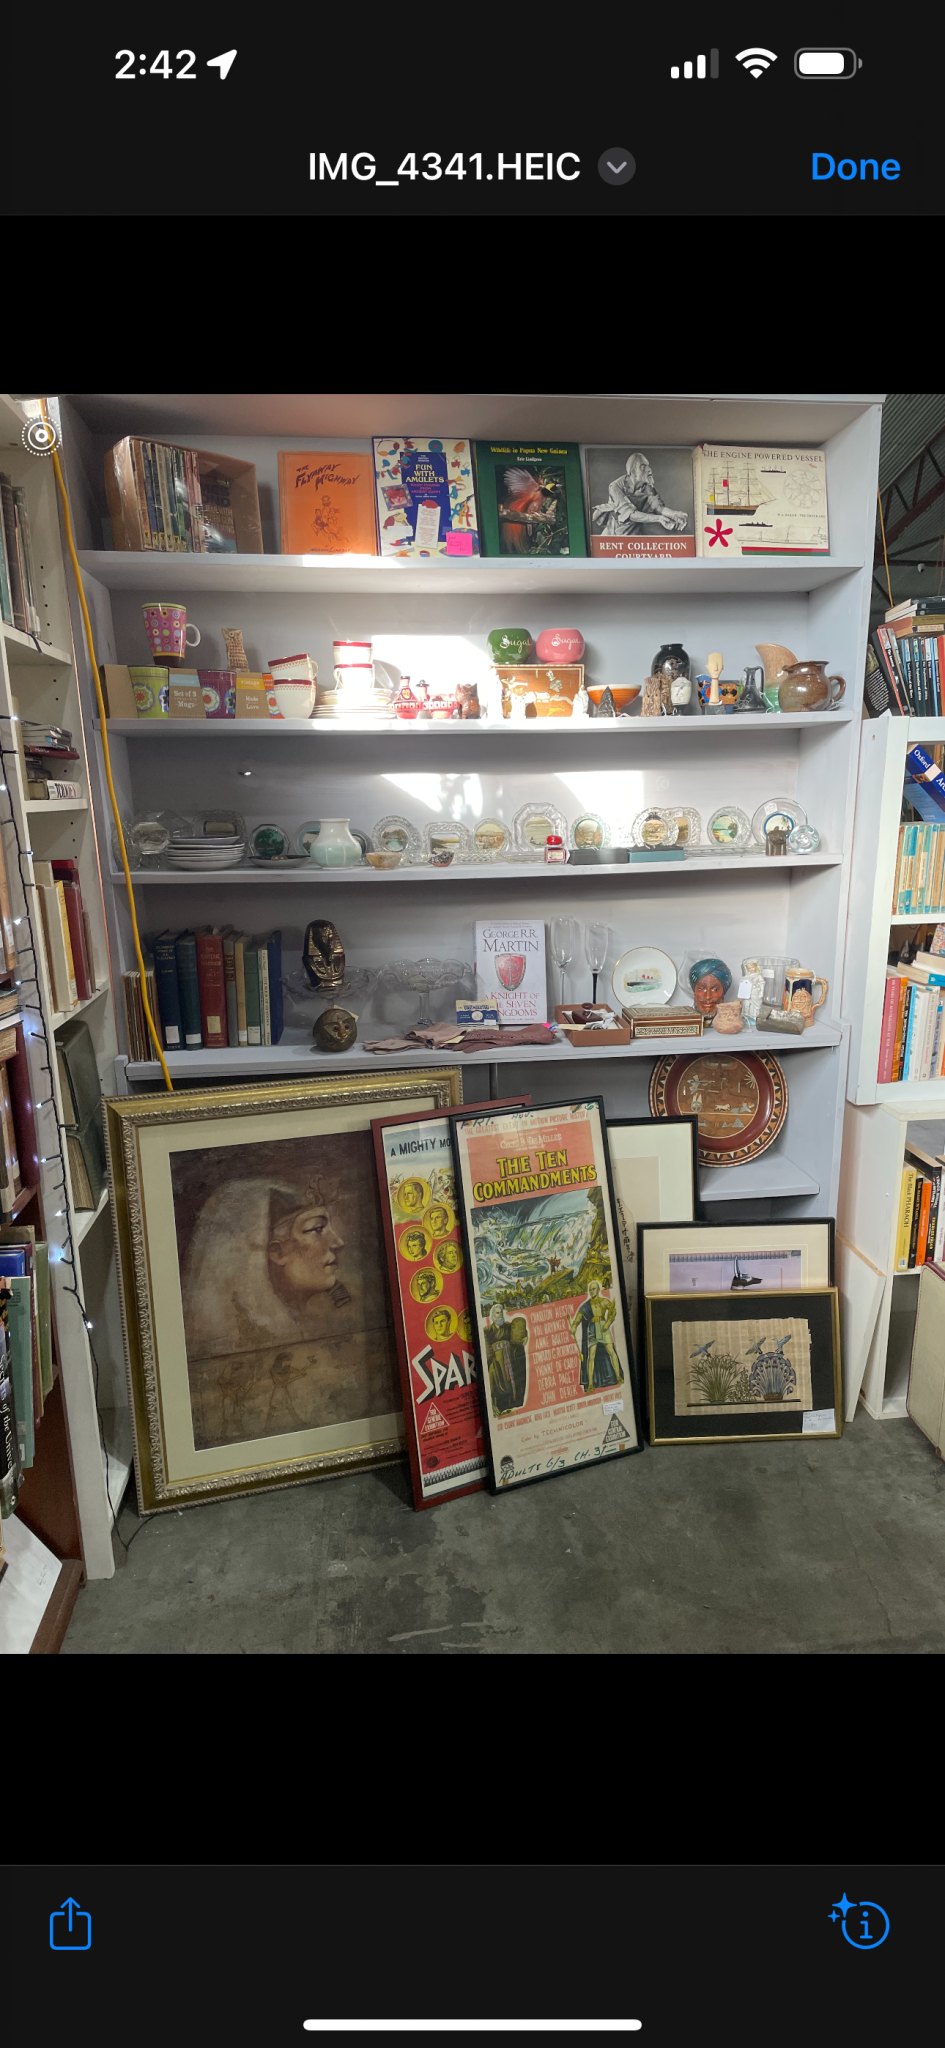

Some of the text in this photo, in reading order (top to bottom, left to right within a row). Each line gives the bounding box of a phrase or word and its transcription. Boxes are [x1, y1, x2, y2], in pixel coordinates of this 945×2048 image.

[720, 451, 752, 459] ENGINE
[795, 454, 824, 462] VESSEL
[295, 464, 341, 489] FLYAWAY
[296, 464, 309, 473] THE
[315, 474, 360, 492] HIGHWAY
[600, 542, 687, 550] RENT COLLECTION
[500, 634, 532, 653] Sugar
[552, 633, 581, 650] Sugar
[914, 750, 931, 769] Oxford
[483, 929, 518, 938] GEORGE
[483, 939, 539, 952] MARTIN
[476, 1124, 499, 1134] GREATEST
[530, 1116, 548, 1126] MOTION
[550, 1113, 568, 1123] PICTURE
[570, 1110, 588, 1120] HISTORY
[391, 1138, 452, 1157] A MIGHTY MO
[500, 1140, 518, 1149] CECIL
[496, 1149, 568, 1178] THE TEN
[473, 1164, 597, 1203] COMMANDMENTS
[904, 1196, 912, 1228] PHARAOH
[530, 1303, 574, 1323] CHARLTON HESTON
[533, 1318, 566, 1336] YUL BRYNNER
[535, 1331, 570, 1350] ANNE BAXTER
[532, 1350, 552, 1364] EDWARD
[556, 1342, 579, 1357] ROBINSON
[412, 1344, 476, 1404] SPAR
[534, 1356, 578, 1378] YVONNE DE CARLO
[538, 1370, 575, 1391] DEBRA PAGET
[541, 1385, 578, 1405] JOHN DEREK
[0, 1403, 10, 1413] of
[541, 1420, 584, 1436] TECHNICOLOR
